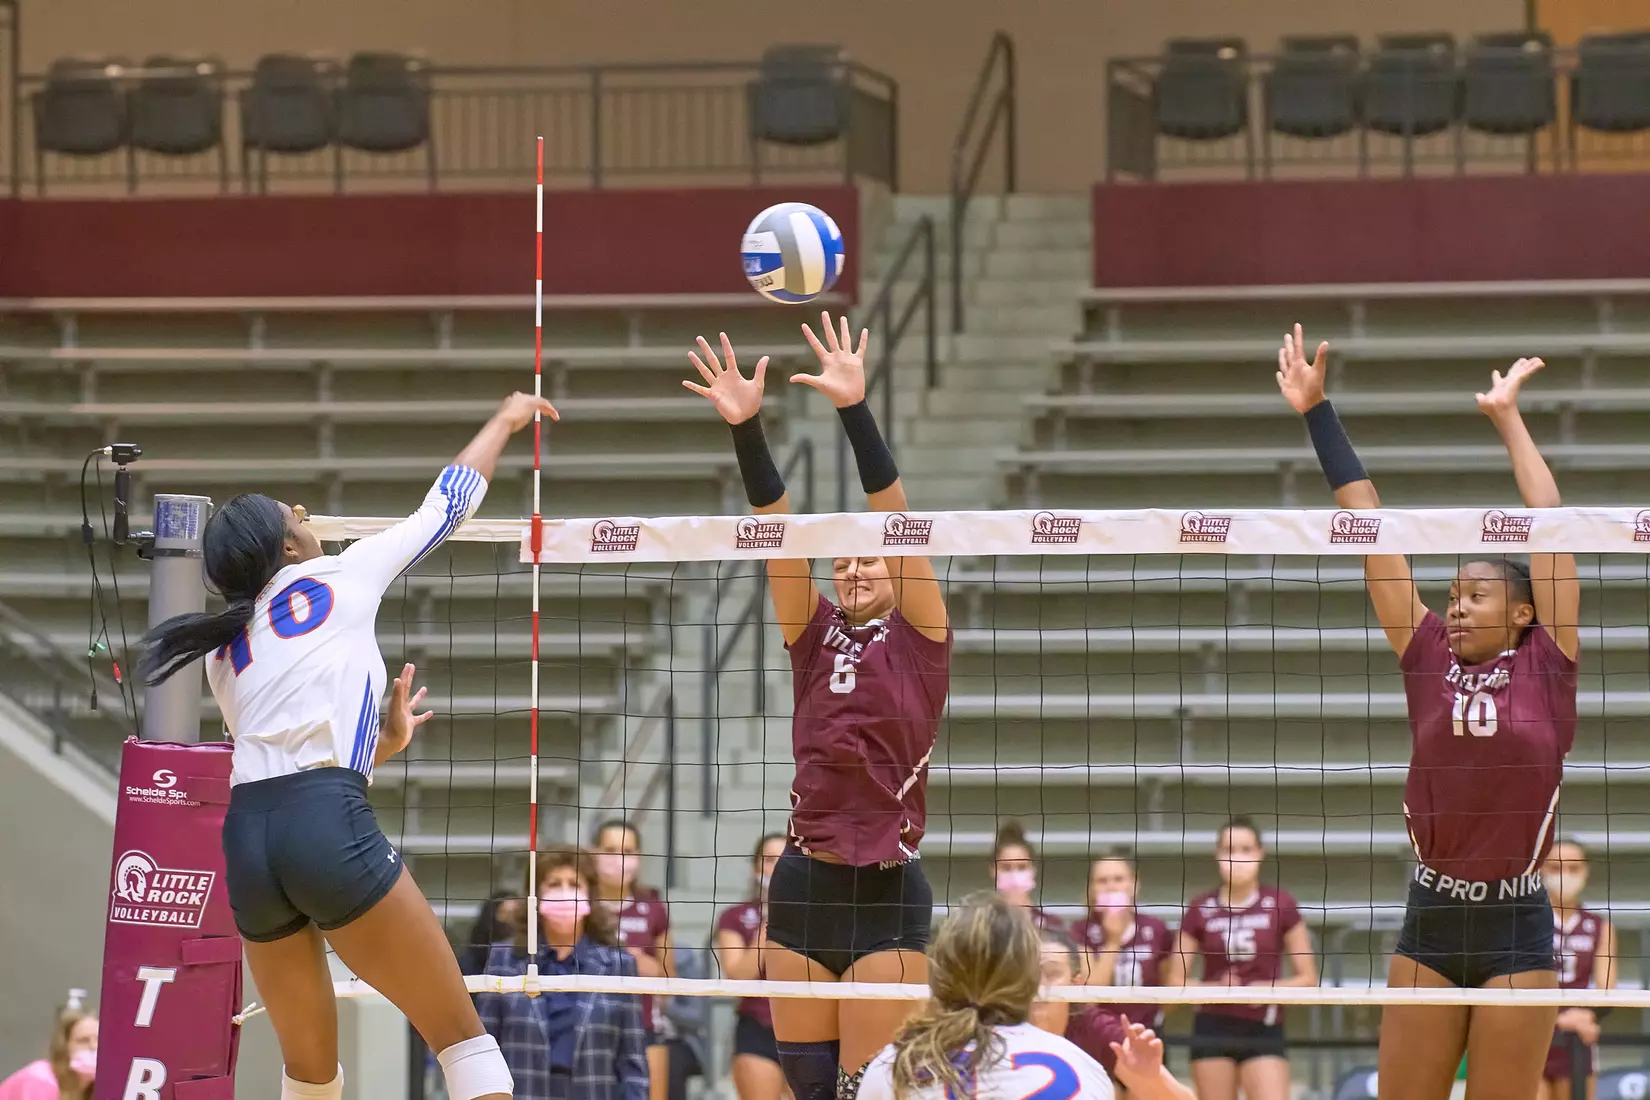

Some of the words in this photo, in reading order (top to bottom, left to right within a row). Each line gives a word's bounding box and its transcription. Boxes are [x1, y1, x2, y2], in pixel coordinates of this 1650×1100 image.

[758, 524, 784, 532] LITTLE
[1202, 518, 1228, 526] LITTLE
[1504, 518, 1530, 526] LITTLE
[612, 527, 638, 535] LITTLE
[904, 528, 928, 536] ROCK
[829, 653, 862, 694] 6
[1452, 691, 1498, 737] 10
[126, 786, 167, 797] Schelde
[152, 873, 209, 890] LITTLE
[1435, 874, 1488, 902] PRO
[147, 890, 204, 905] ROCK
[114, 907, 195, 924] VOLLEYBALL
